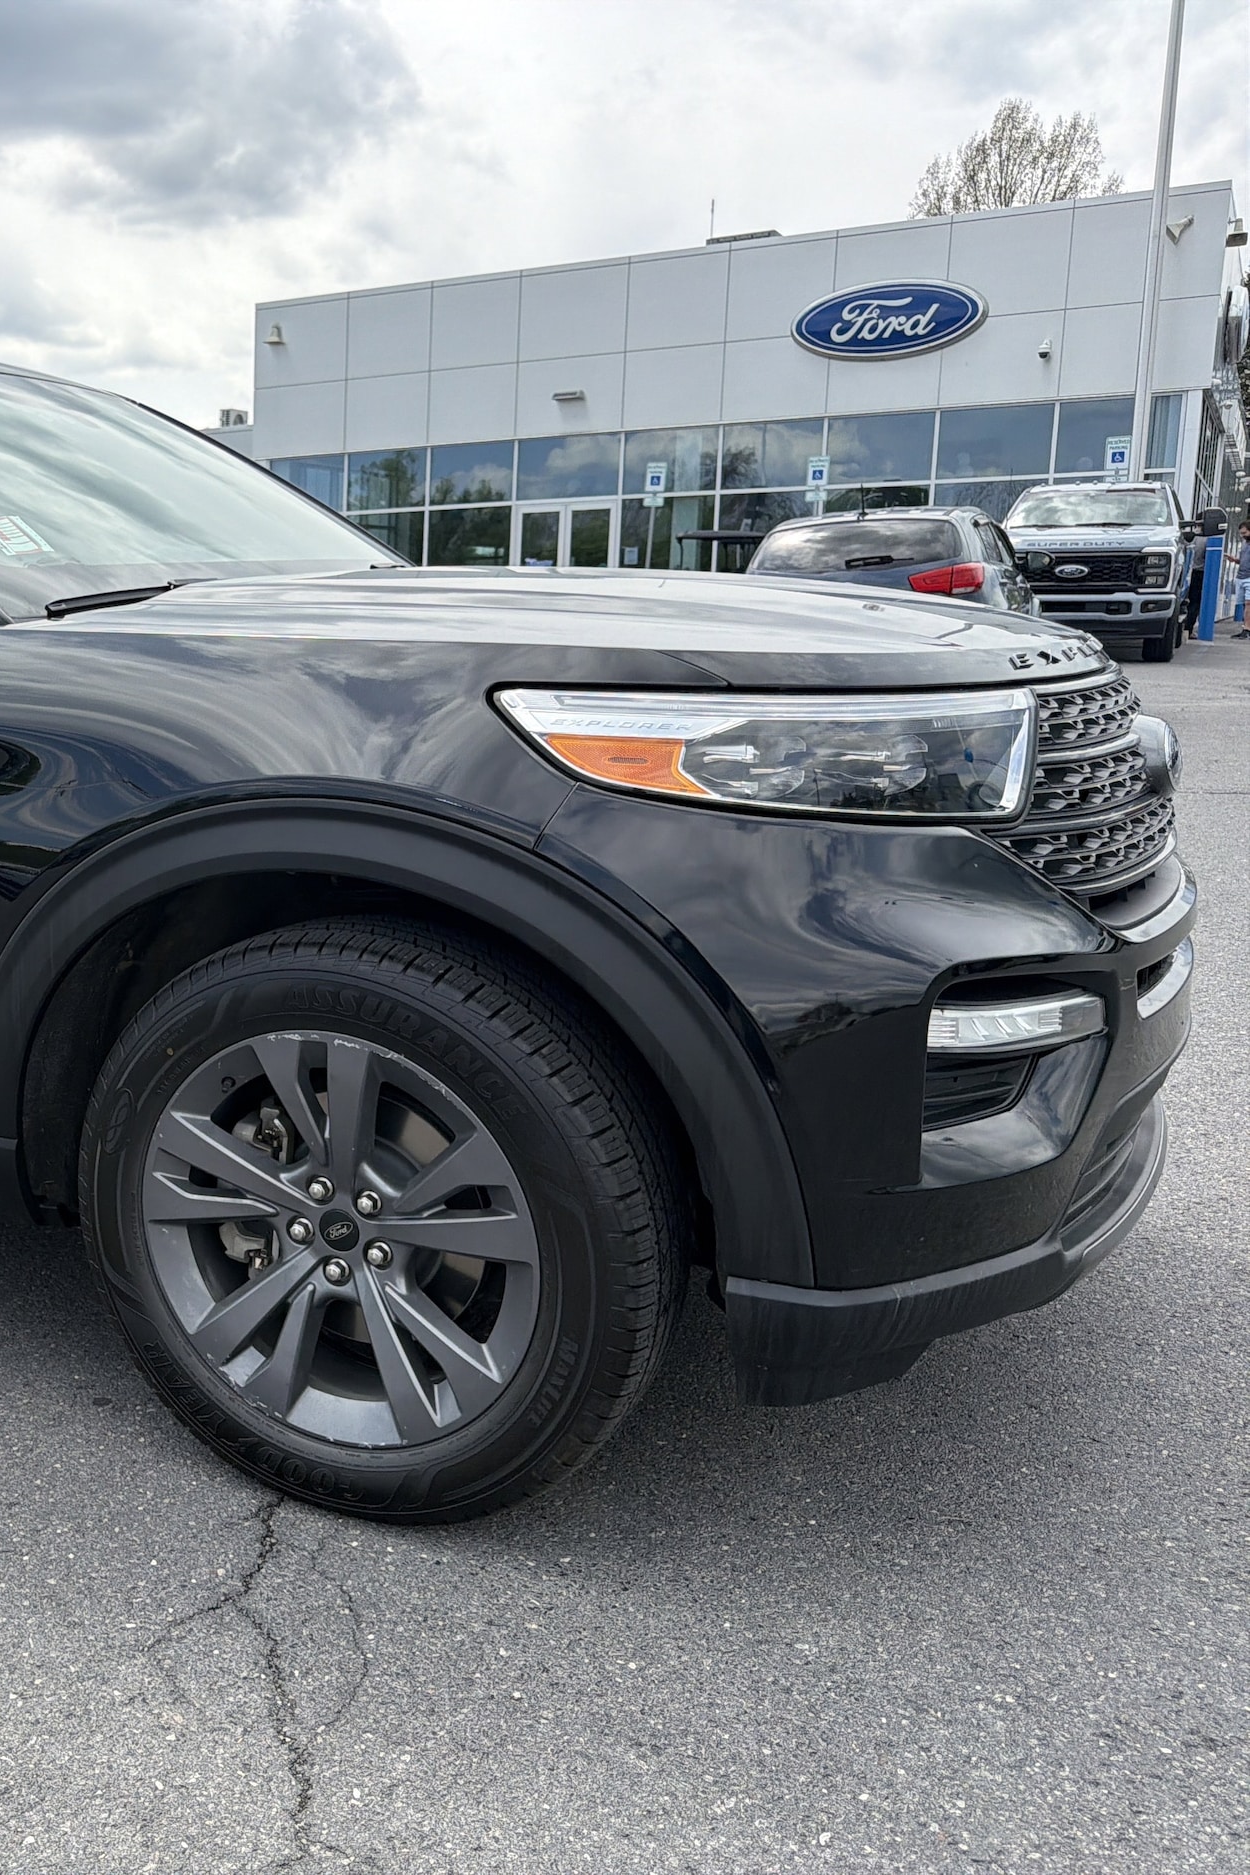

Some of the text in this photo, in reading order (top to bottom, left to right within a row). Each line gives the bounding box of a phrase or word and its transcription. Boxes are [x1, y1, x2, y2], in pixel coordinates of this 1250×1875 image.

[830, 297, 940, 343] Ford
[550, 717, 693, 731] EXPLORER
[283, 983, 530, 1121] ASSURANCE
